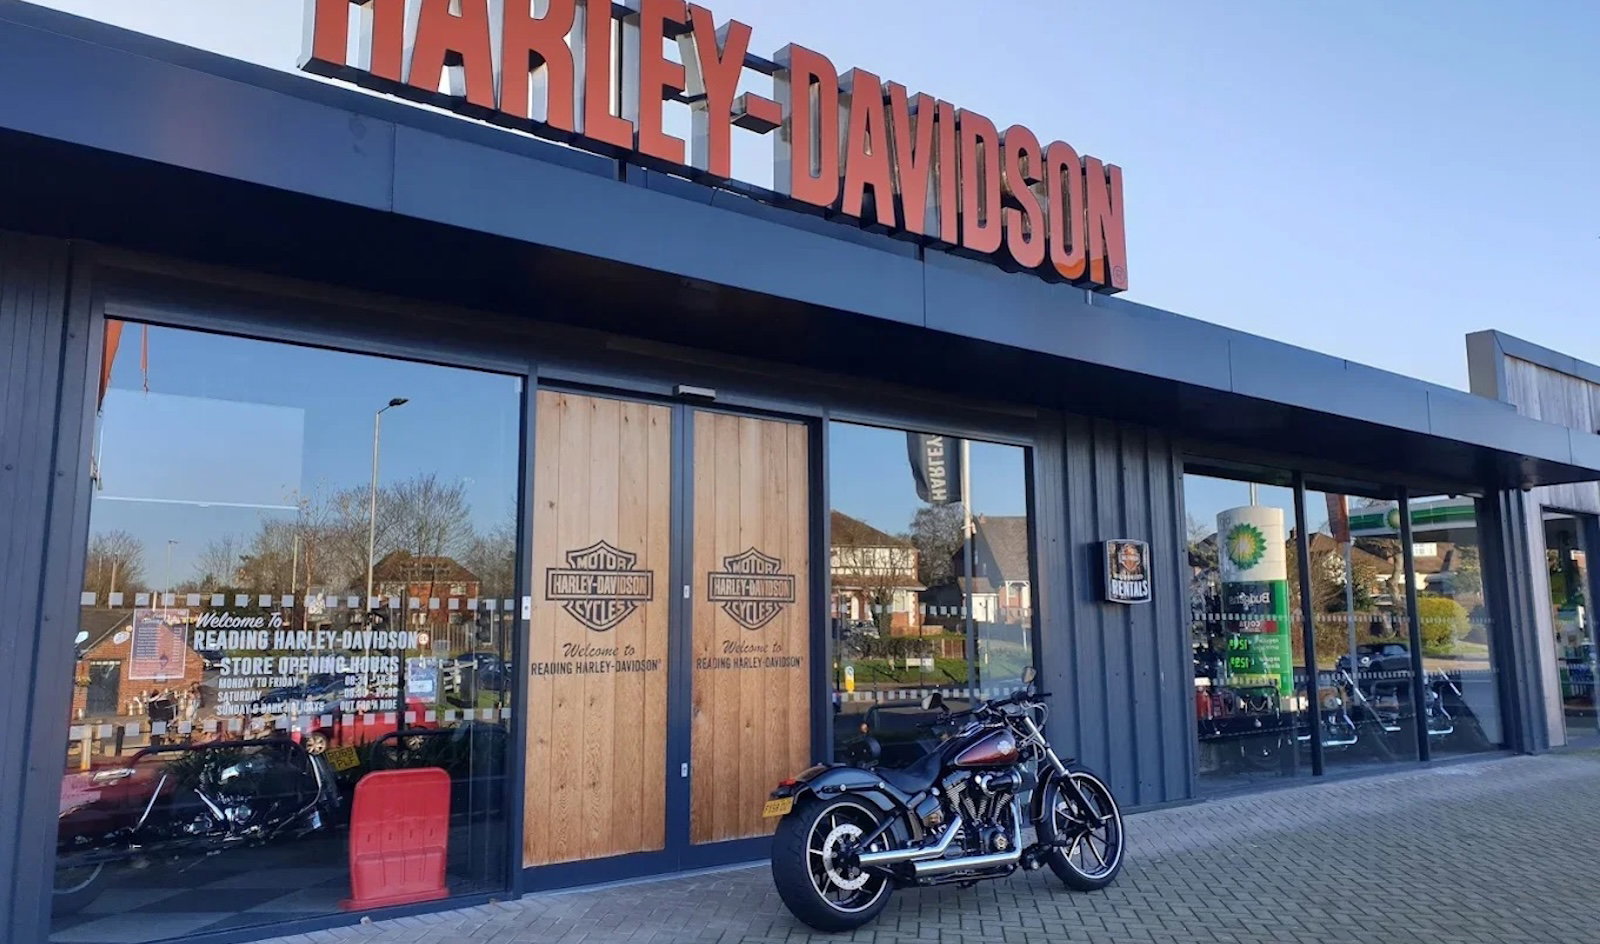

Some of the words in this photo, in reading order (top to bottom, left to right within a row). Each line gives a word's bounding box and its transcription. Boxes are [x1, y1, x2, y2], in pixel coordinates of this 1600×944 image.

[576, 550, 627, 570] MOTOR
[732, 555, 774, 574] MOTOR
[553, 574, 647, 596] HARLEY-DAVIDSON
[713, 577, 790, 598] HARLEY-DAVIDSON
[1111, 579, 1148, 597] RENTALS
[195, 612, 264, 629] Welcome
[268, 611, 282, 628] To
[575, 600, 625, 625] CYCLES
[732, 601, 773, 624] CYCLES
[193, 630, 268, 650] READING
[273, 630, 418, 650] HARLEY-DAVIDSON
[723, 640, 768, 654] Welcome
[772, 642, 782, 653] to
[562, 643, 618, 658] Welcome
[624, 644, 635, 656] to
[219, 657, 274, 676] STORE
[278, 656, 345, 675] OPENING
[350, 656, 399, 674] HOURS
[531, 660, 572, 676] READING
[575, 659, 658, 675] HARLEY-DAVIDSON
[696, 657, 731, 669] READING
[733, 656, 800, 669] HARLEY-DAVIDSON
[218, 677, 254, 689] MONDAY
[256, 677, 267, 688] TO
[268, 676, 298, 687] FRIDAY
[217, 691, 262, 702] SATURDAY
[216, 704, 251, 716] SUNDAY
[380, 700, 398, 710] RIDE
